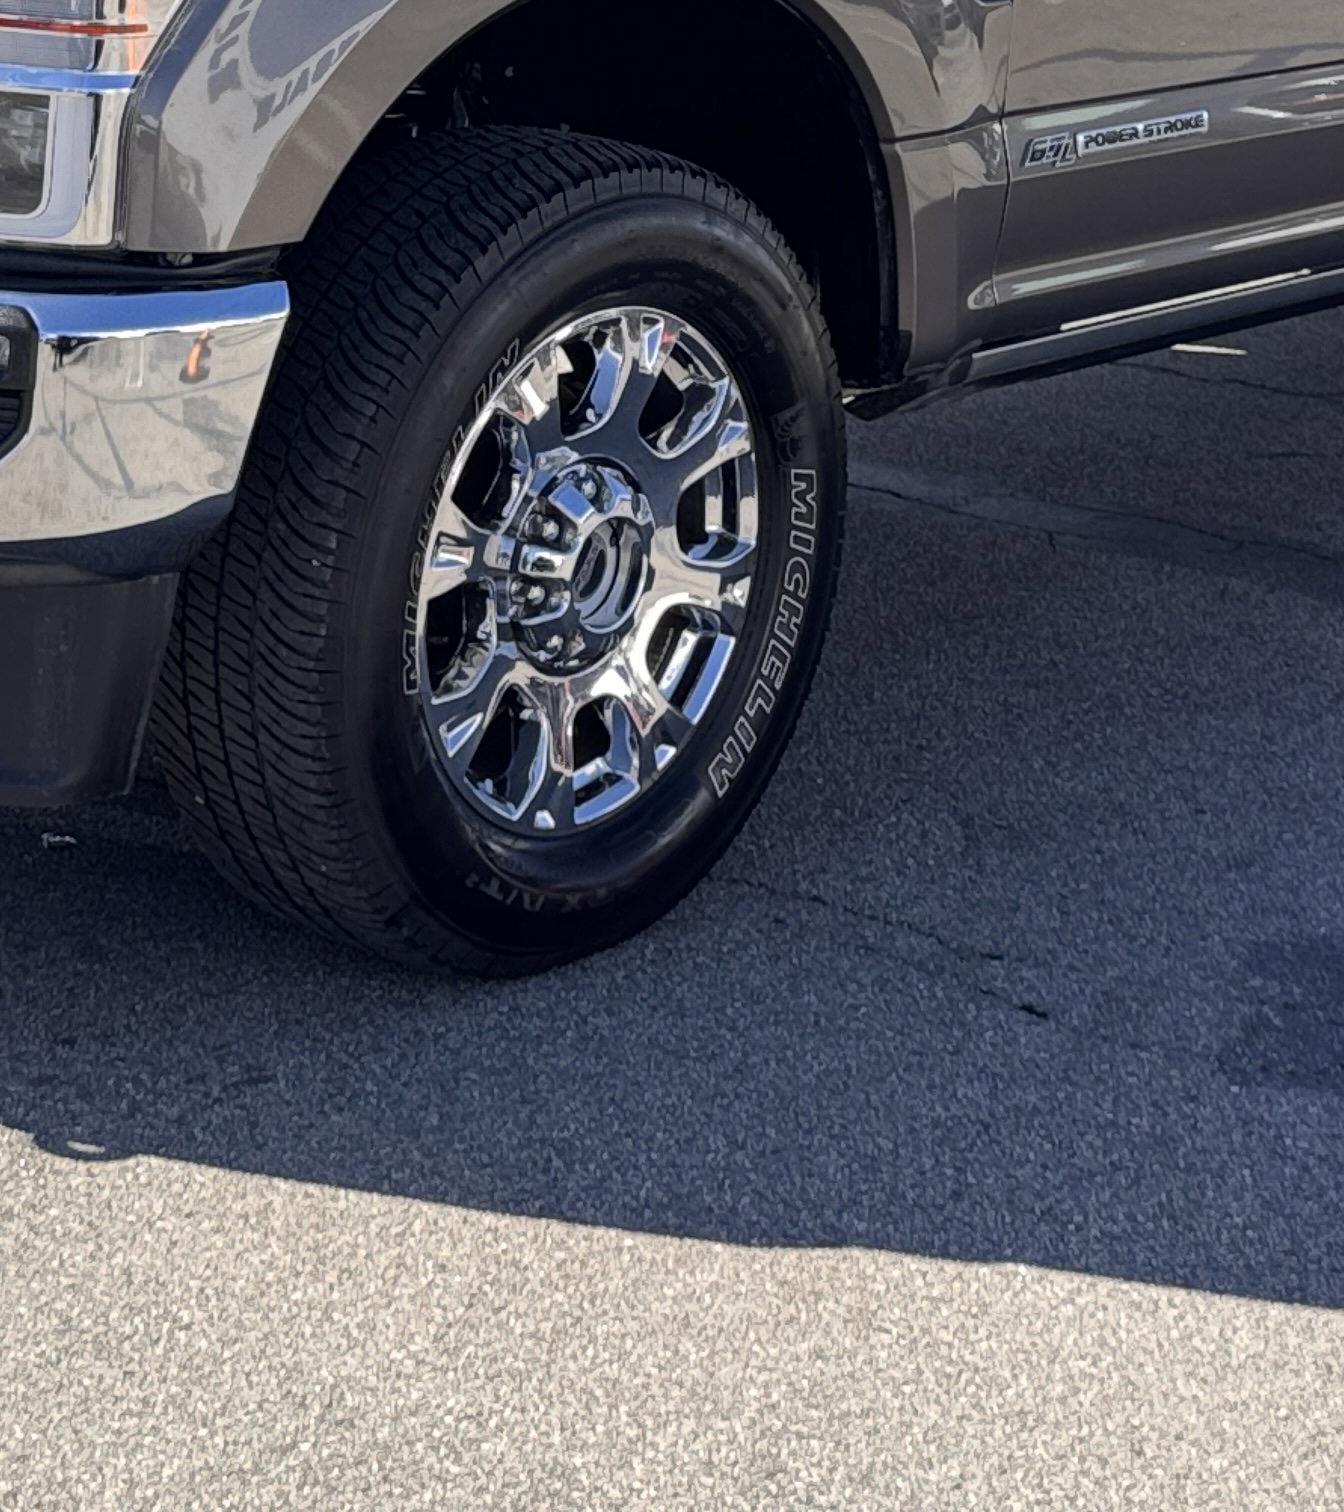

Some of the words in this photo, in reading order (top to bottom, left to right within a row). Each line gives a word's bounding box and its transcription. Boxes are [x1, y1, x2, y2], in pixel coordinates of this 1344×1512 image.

[1083, 126, 1141, 150] POWER
[1142, 113, 1206, 138] STROKE
[708, 468, 817, 798] MICHELIN
